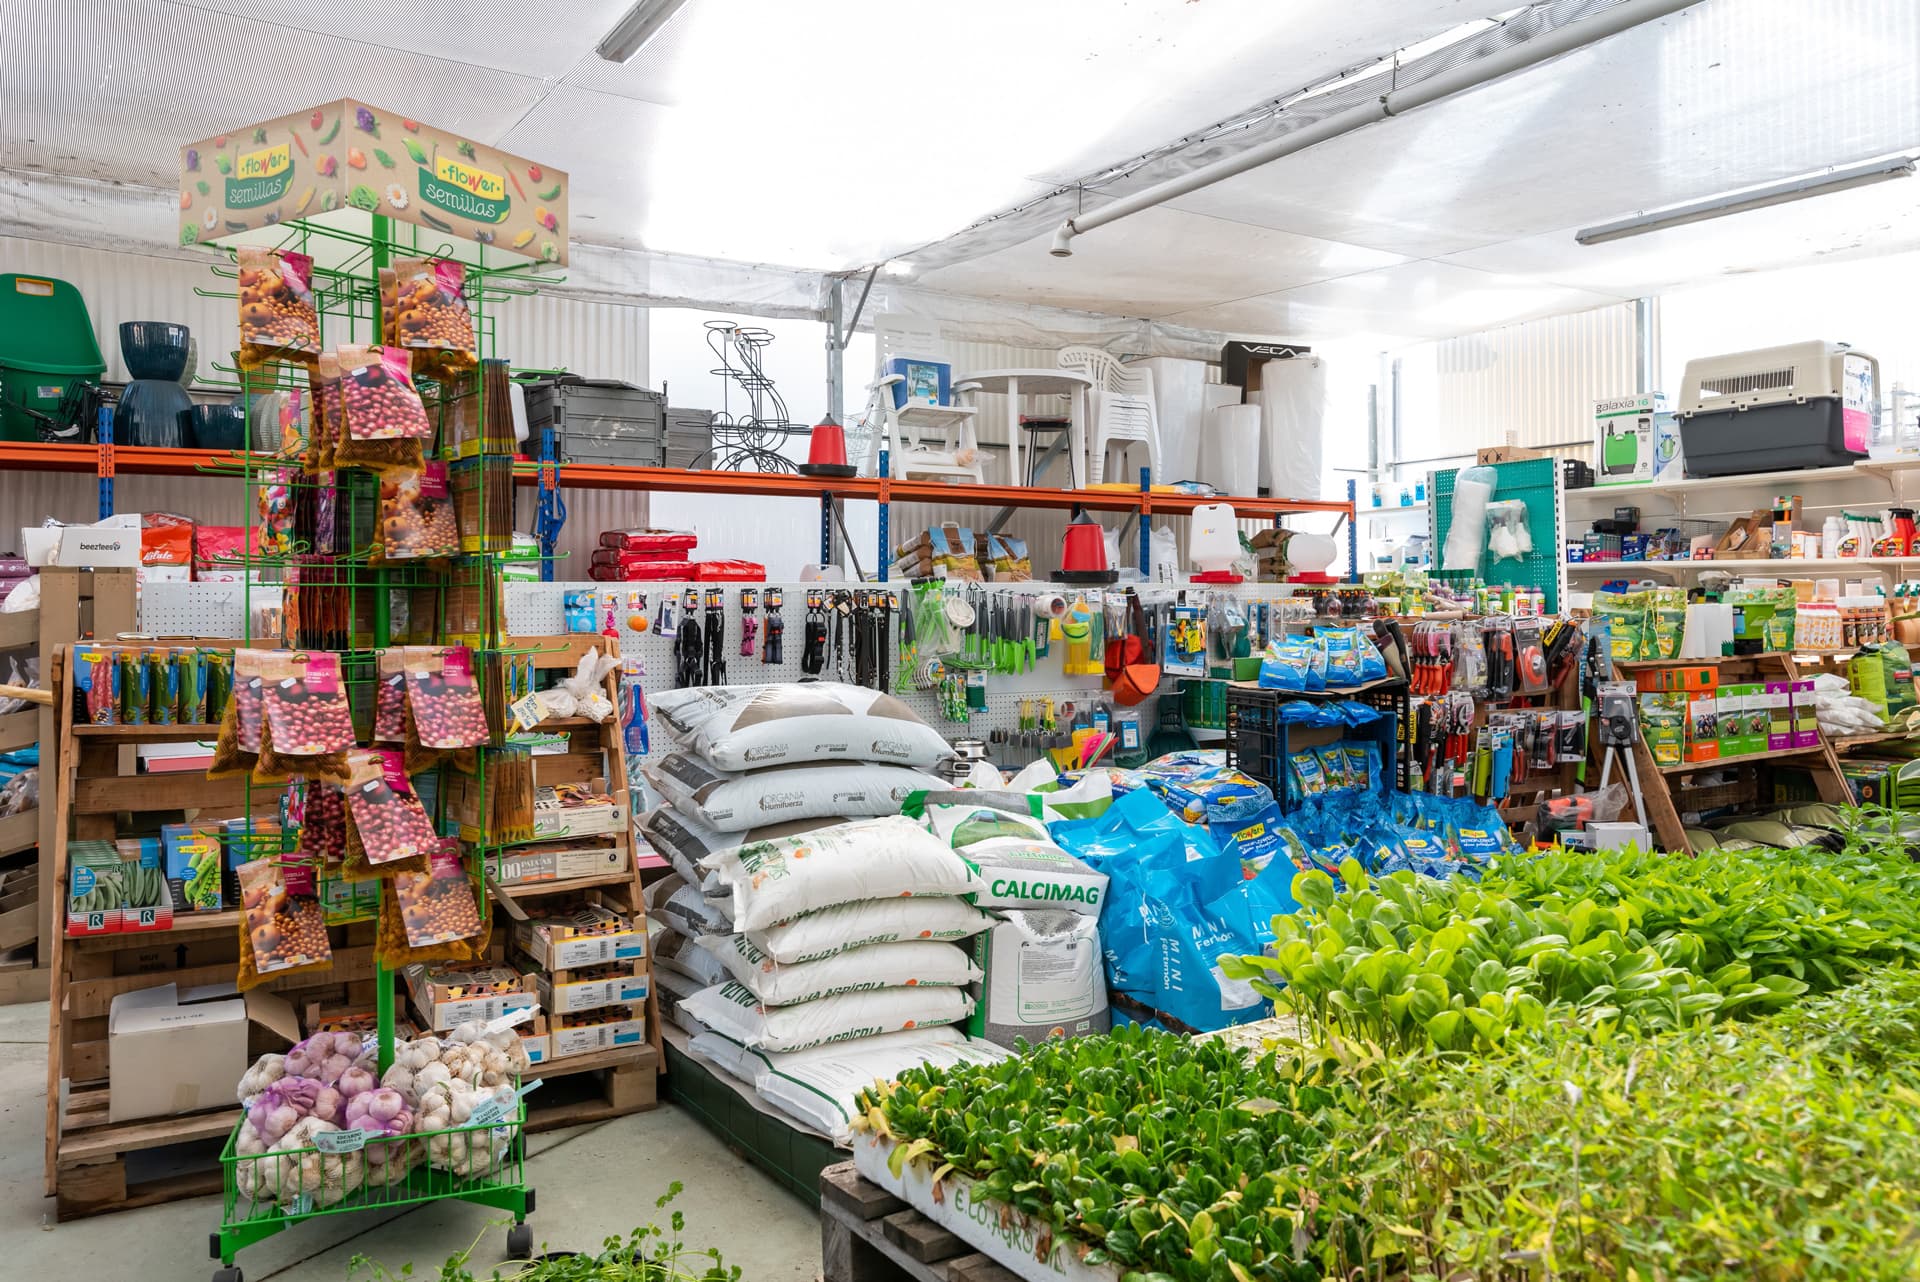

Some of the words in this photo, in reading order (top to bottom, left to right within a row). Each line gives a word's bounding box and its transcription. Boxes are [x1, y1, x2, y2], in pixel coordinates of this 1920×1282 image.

[448, 165, 496, 194] flower
[230, 177, 282, 204] semillas
[425, 182, 496, 218] semillas
[1241, 345, 1297, 356] VECA
[1596, 400, 1635, 414] galaxia
[80, 542, 113, 551] beeztees
[764, 791, 805, 803] ORGANIA
[765, 800, 803, 811] Humifuerza
[991, 879, 1099, 904] CALCIMAG
[1169, 938, 1184, 992] MINI
